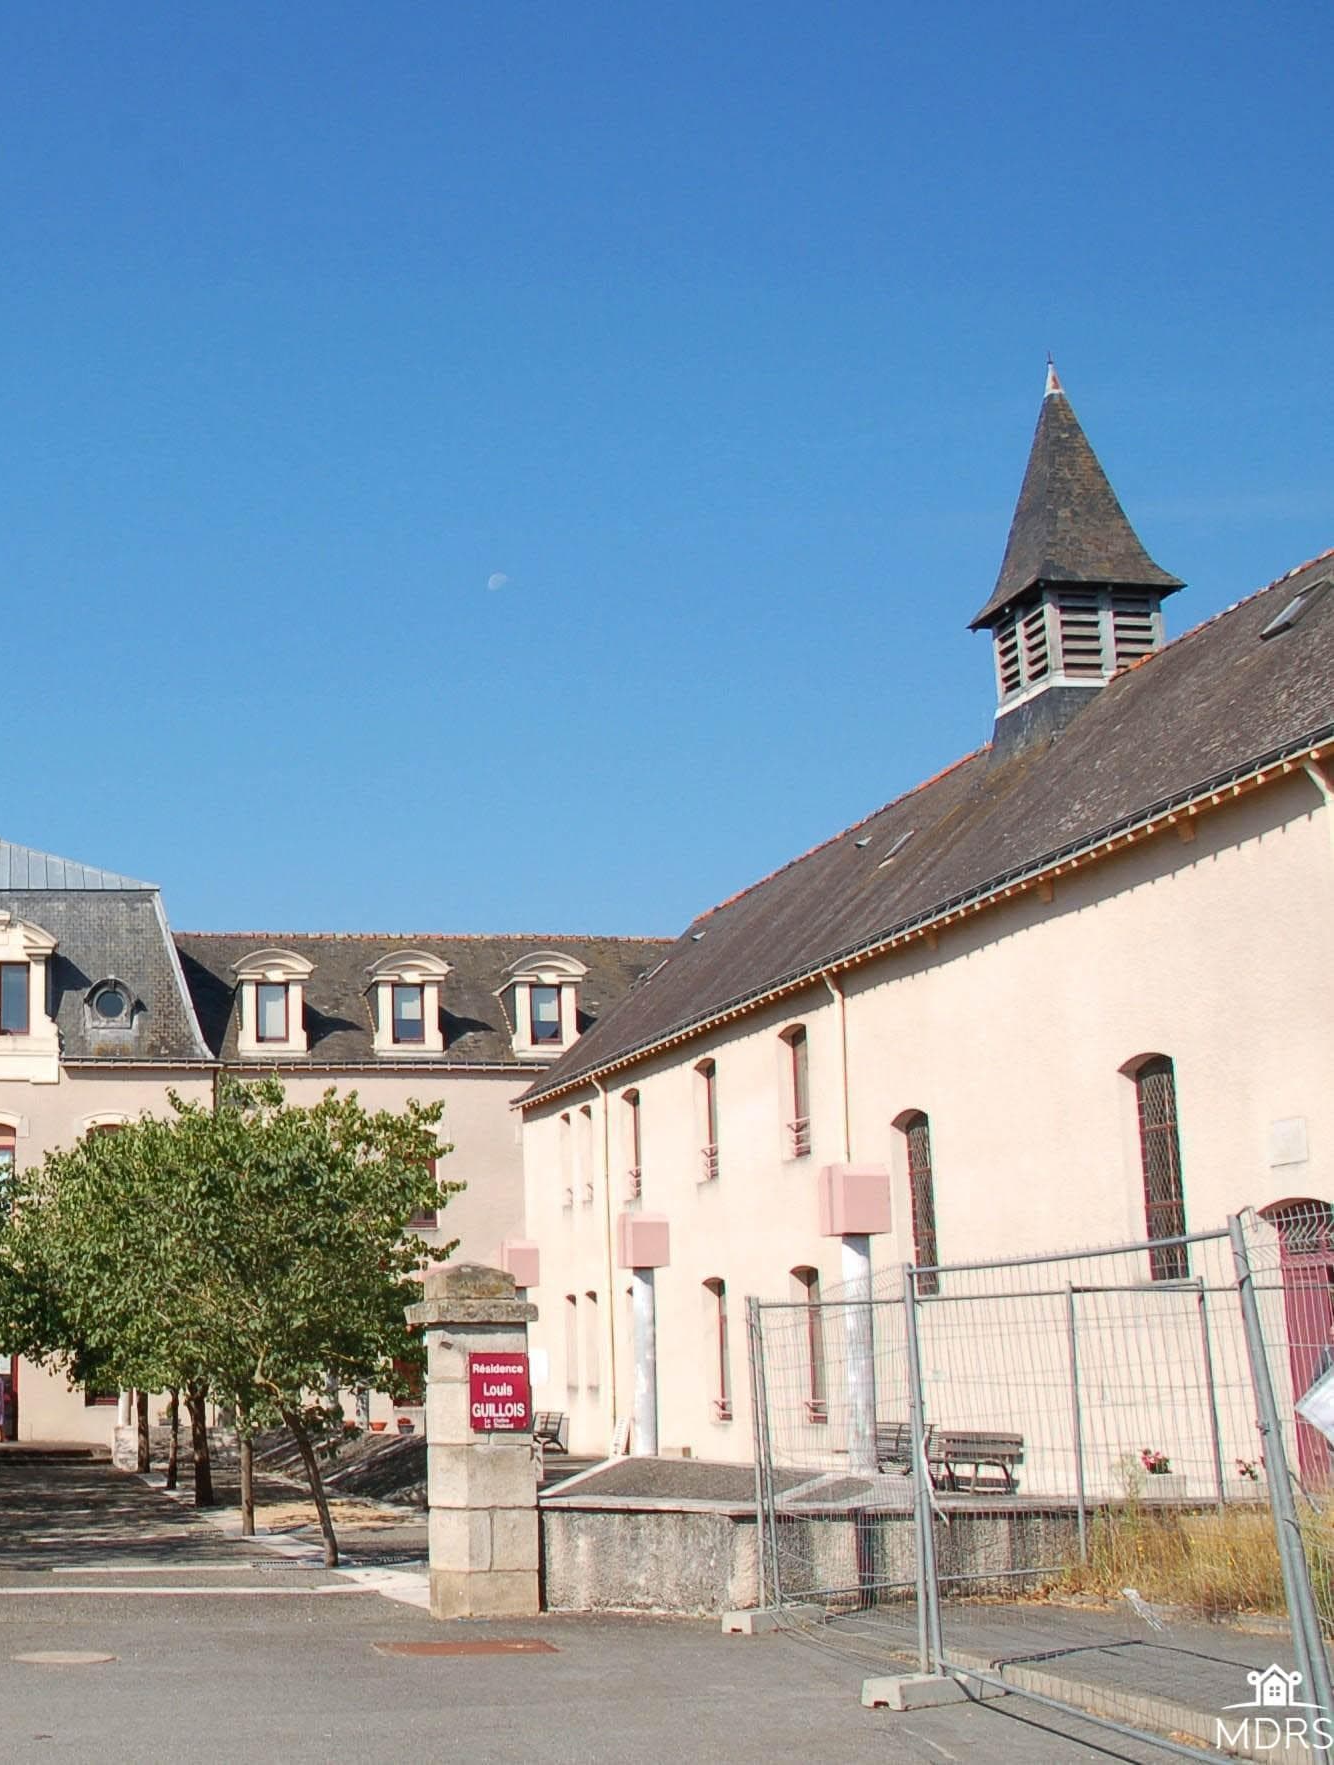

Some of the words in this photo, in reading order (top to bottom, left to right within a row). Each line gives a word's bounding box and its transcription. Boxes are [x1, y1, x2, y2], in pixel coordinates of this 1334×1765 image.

[472, 1363, 524, 1374] Résidence
[483, 1382, 513, 1396] Louis
[472, 1402, 525, 1417] GUILLOIS
